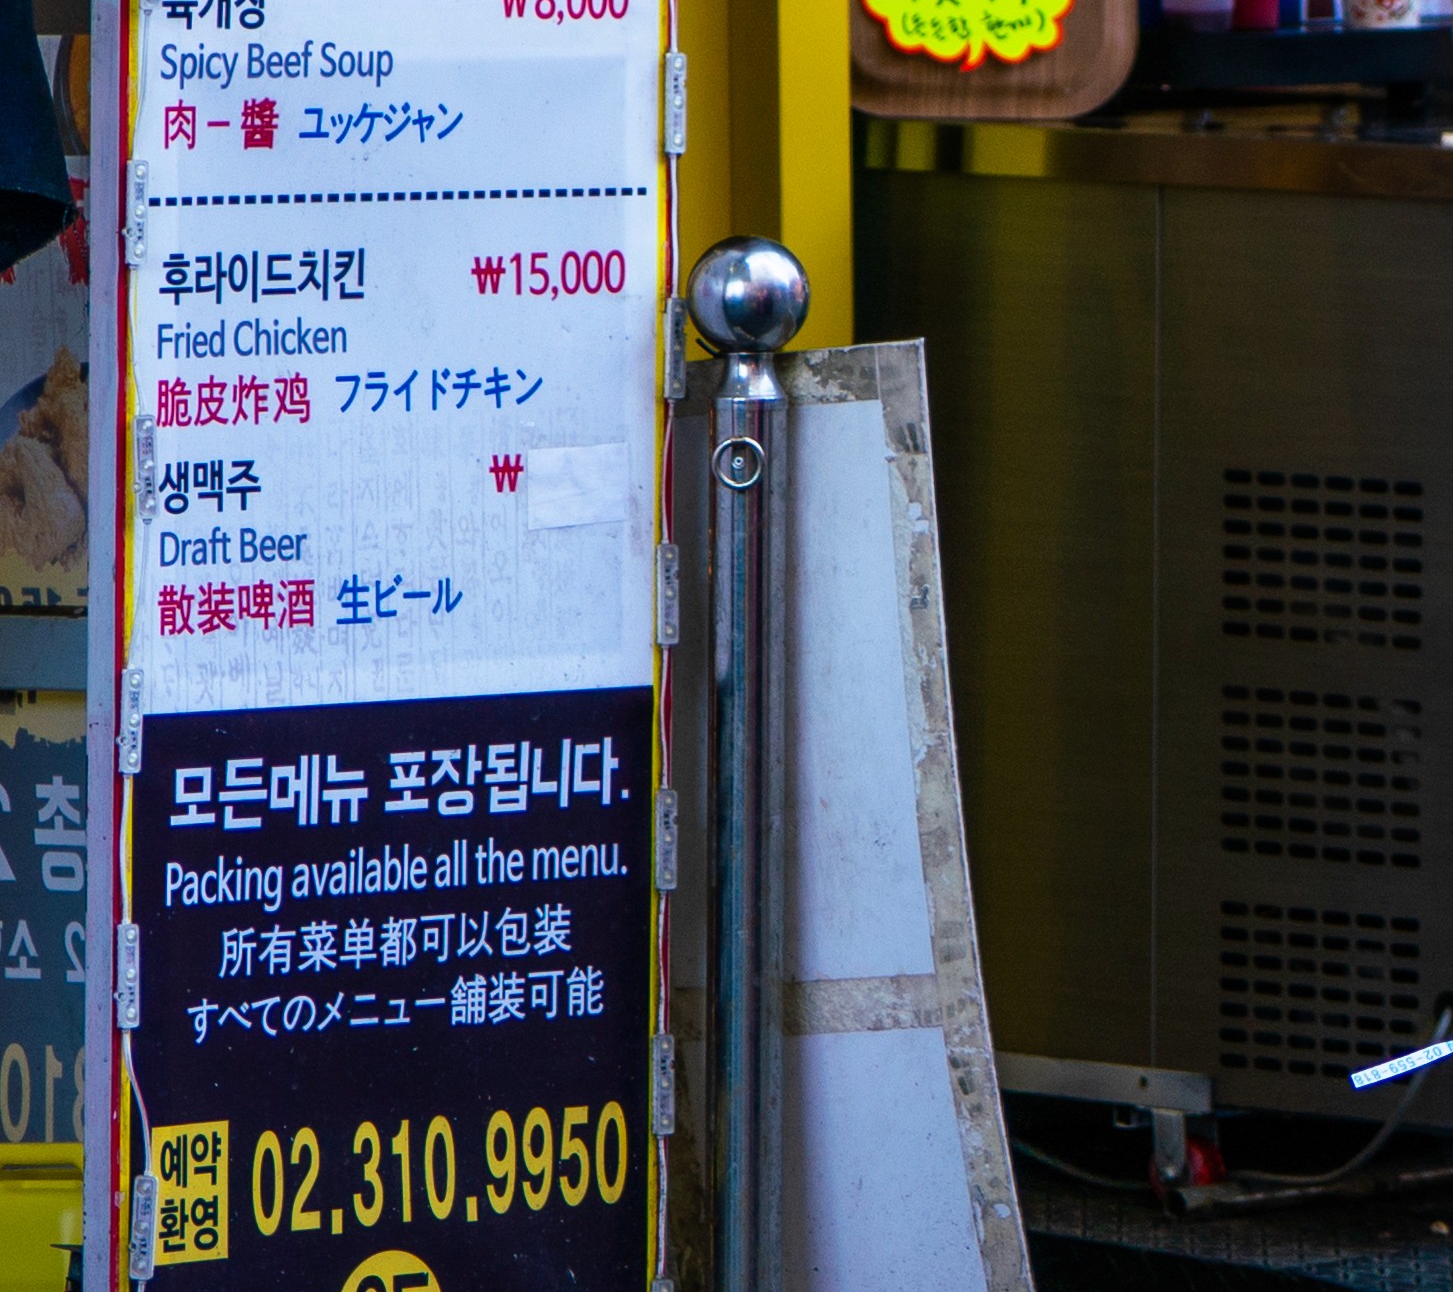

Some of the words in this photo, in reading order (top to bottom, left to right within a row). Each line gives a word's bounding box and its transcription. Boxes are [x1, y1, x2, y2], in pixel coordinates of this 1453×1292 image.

[160, 42, 238, 89] Spicy
[247, 39, 315, 79] Beef
[319, 41, 394, 87] Soup
[298, 102, 464, 146] ユッケジャン
[158, 246, 366, 306] 후라이드치킨
[471, 248, 626, 301] ₩15,000
[156, 318, 226, 359] Fried
[233, 316, 348, 357] Chicken
[155, 371, 311, 428] 脆皮炸鸡
[334, 365, 544, 413] フライドチキン
[158, 459, 262, 515] 생맥주
[159, 526, 231, 567] Draft
[239, 526, 307, 564] Beer
[157, 577, 316, 637] 散装啤酒
[335, 573, 464, 626] 生ビール
[169, 753, 369, 831] 모든메뉴
[384, 736, 631, 817] 포장됩니다.
[165, 855, 283, 912] Packing
[290, 844, 428, 898] available
[434, 839, 468, 888] all
[475, 837, 525, 886] the
[531, 842, 628, 882] menu.
[217, 903, 572, 979] 所有菜单都可以包装
[186, 964, 605, 1045] すべてのメニュー舗装可能
[160, 1130, 222, 1189] 예약
[252, 1099, 628, 1237] 02.310.9950
[159, 1195, 219, 1254] 환영
